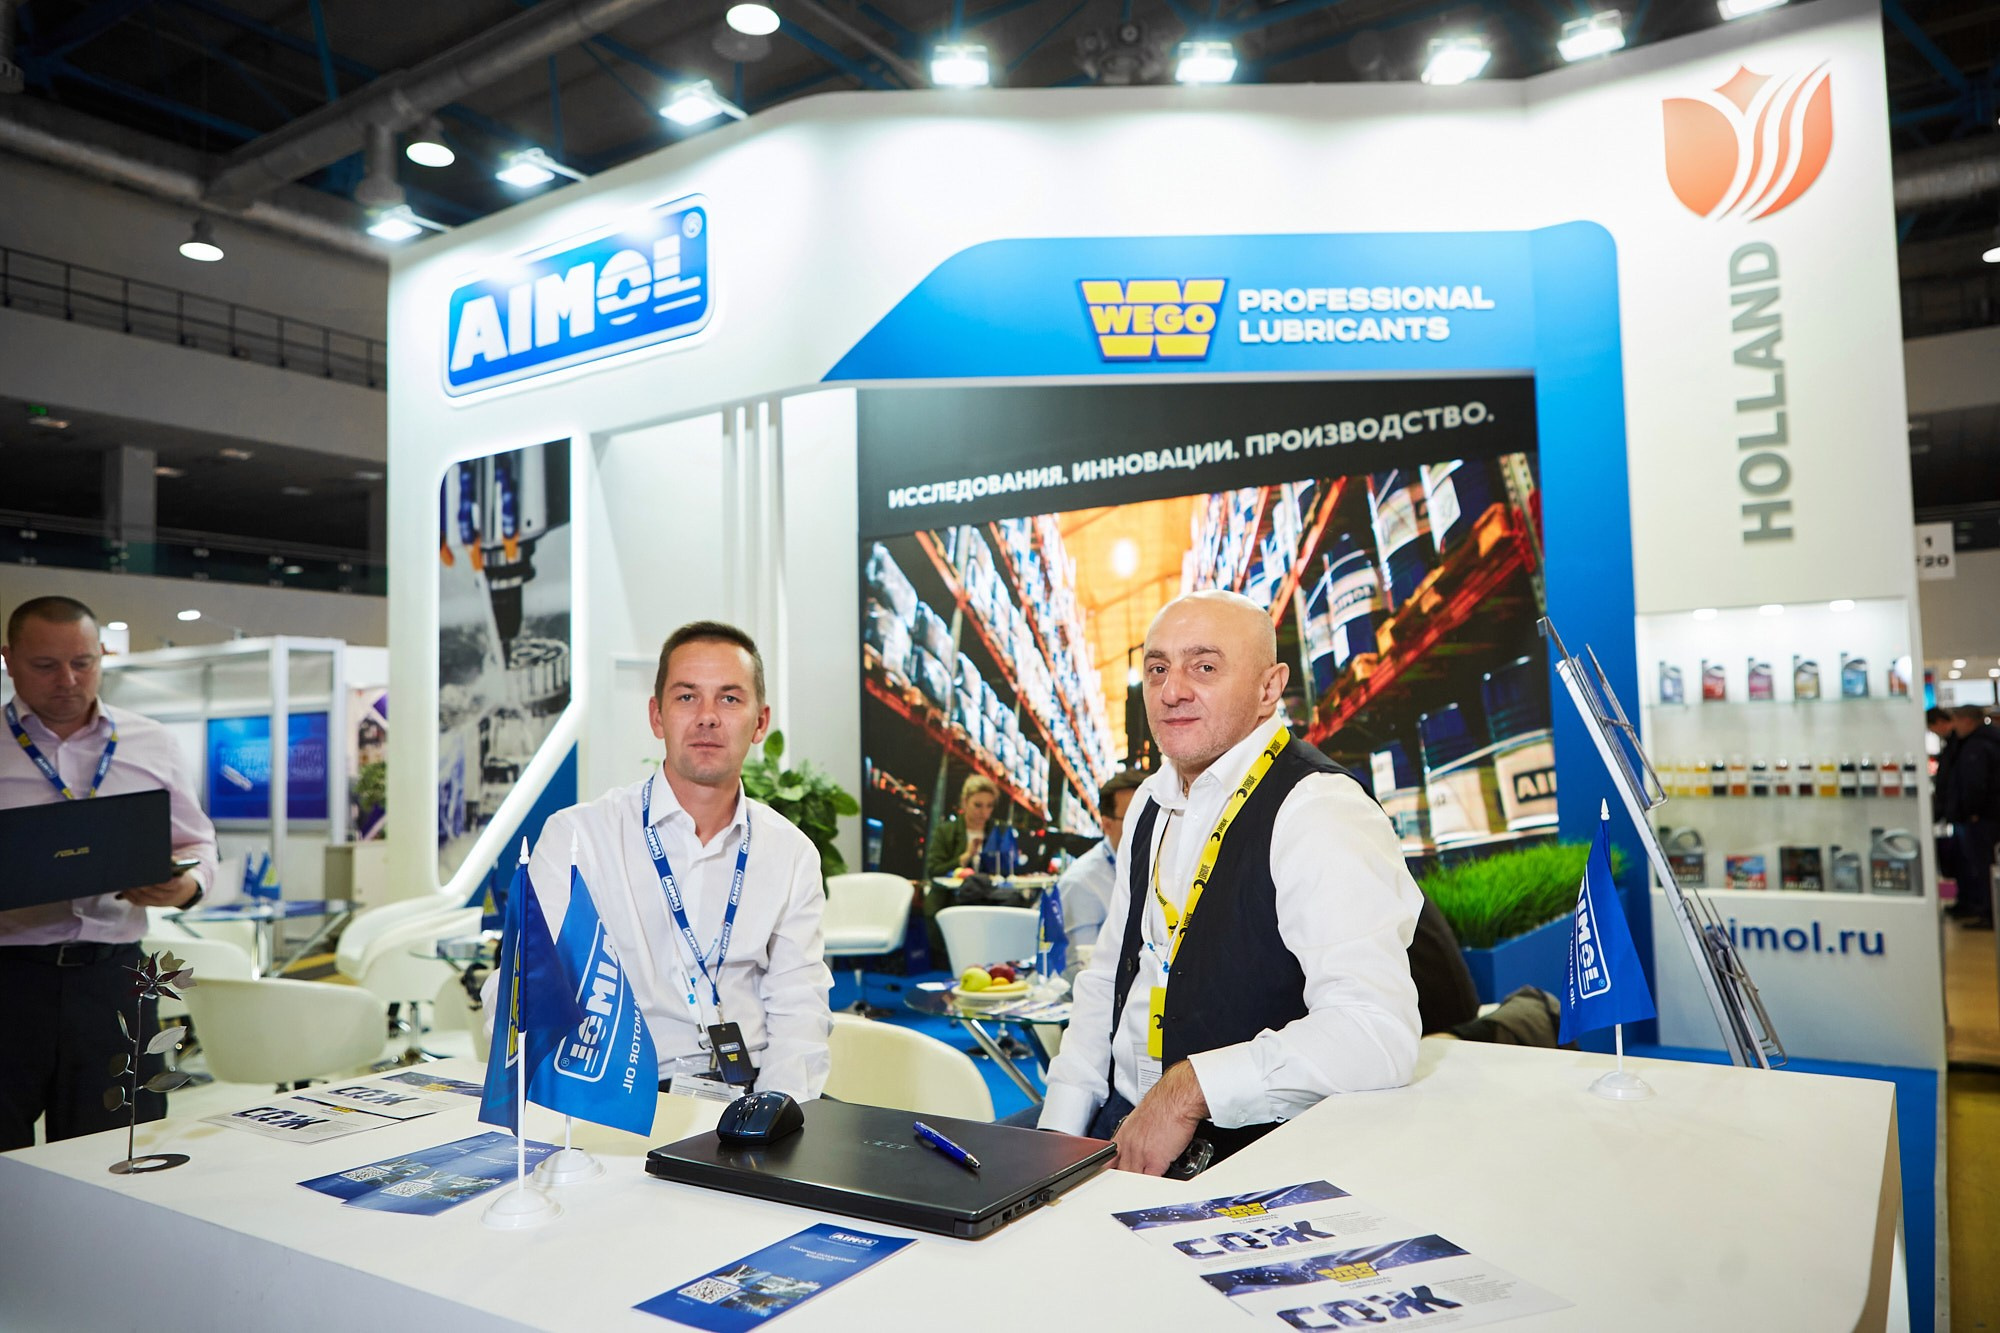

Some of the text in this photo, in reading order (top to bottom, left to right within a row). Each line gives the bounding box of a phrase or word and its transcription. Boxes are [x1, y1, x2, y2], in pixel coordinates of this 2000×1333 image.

[450, 234, 702, 373] AIMOL
[1238, 286, 1495, 313] PROFESSIONAL
[1088, 303, 1217, 335] WEGO
[1239, 316, 1450, 343] LUBRICANTS
[1729, 241, 1795, 543] HOLLAND
[888, 401, 1495, 508] ИССЛЕДОВАНИЯ. ИННОВАЦИИ. ПРОИЗВОДСТВО.
[664, 878, 682, 909] AIMOL
[1172, 1220, 1336, 1260] СОЖ
